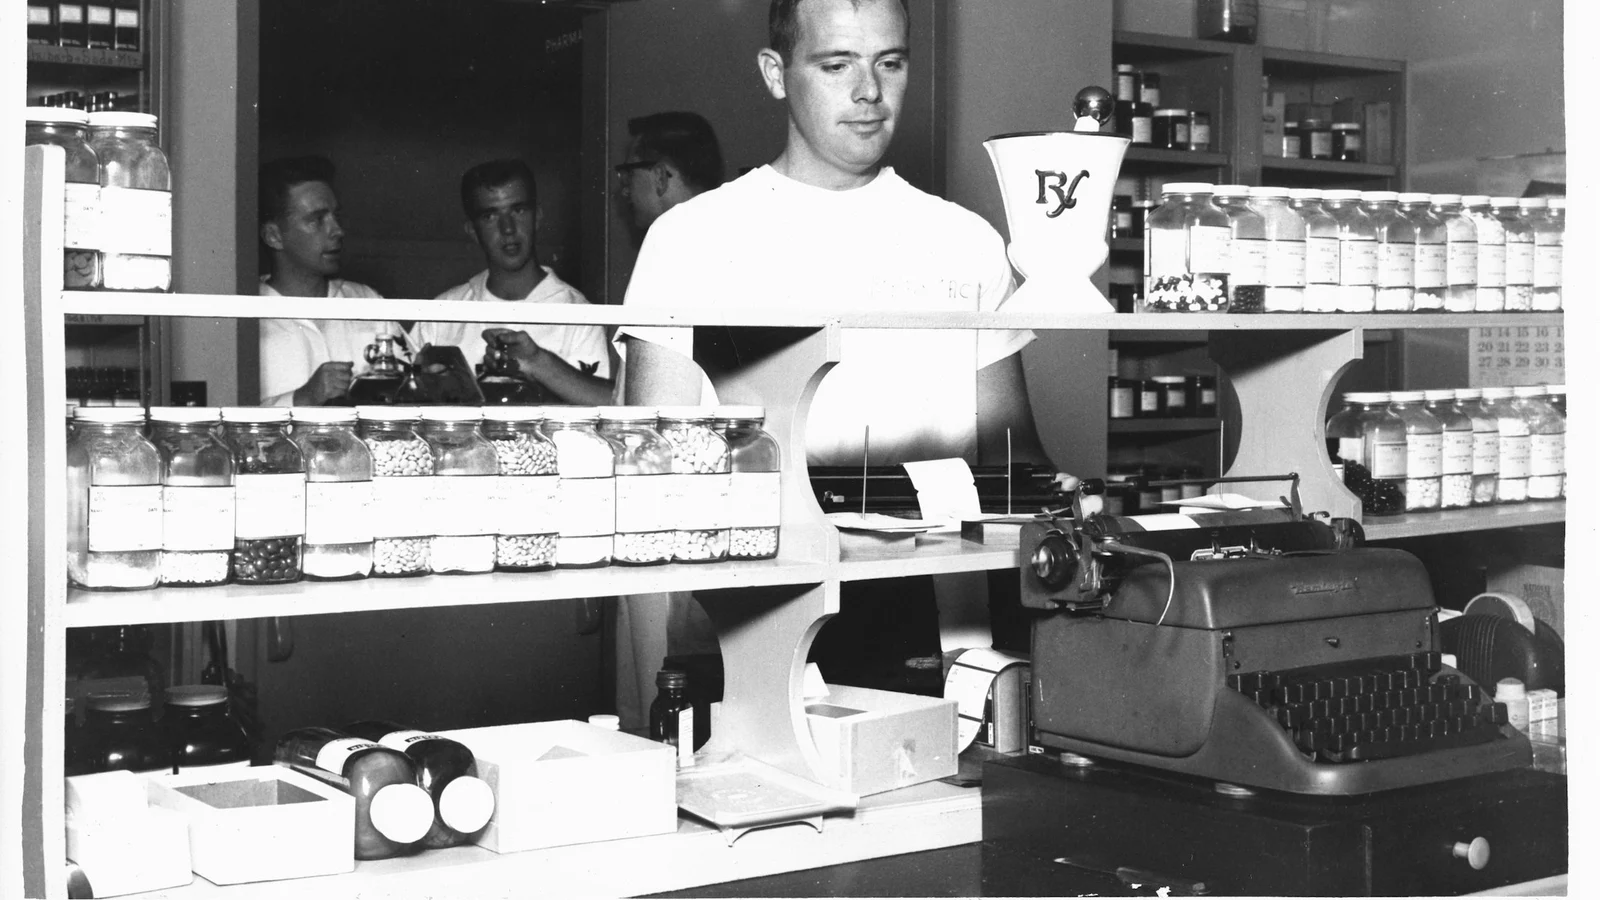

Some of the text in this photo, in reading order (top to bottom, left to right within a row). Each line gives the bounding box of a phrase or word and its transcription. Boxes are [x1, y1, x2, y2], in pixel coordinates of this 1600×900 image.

[1480, 327, 1492, 338] 13
[1498, 327, 1510, 338] 14
[1516, 327, 1529, 338] 15
[1535, 327, 1549, 338] 16
[1478, 341, 1493, 353] 20
[1497, 341, 1510, 353] 21
[1515, 341, 1530, 353] 22
[1535, 341, 1549, 353] 23
[1478, 356, 1492, 368] 27
[1497, 356, 1511, 368] 28
[1515, 356, 1530, 368] 29
[1535, 356, 1549, 368] 30
